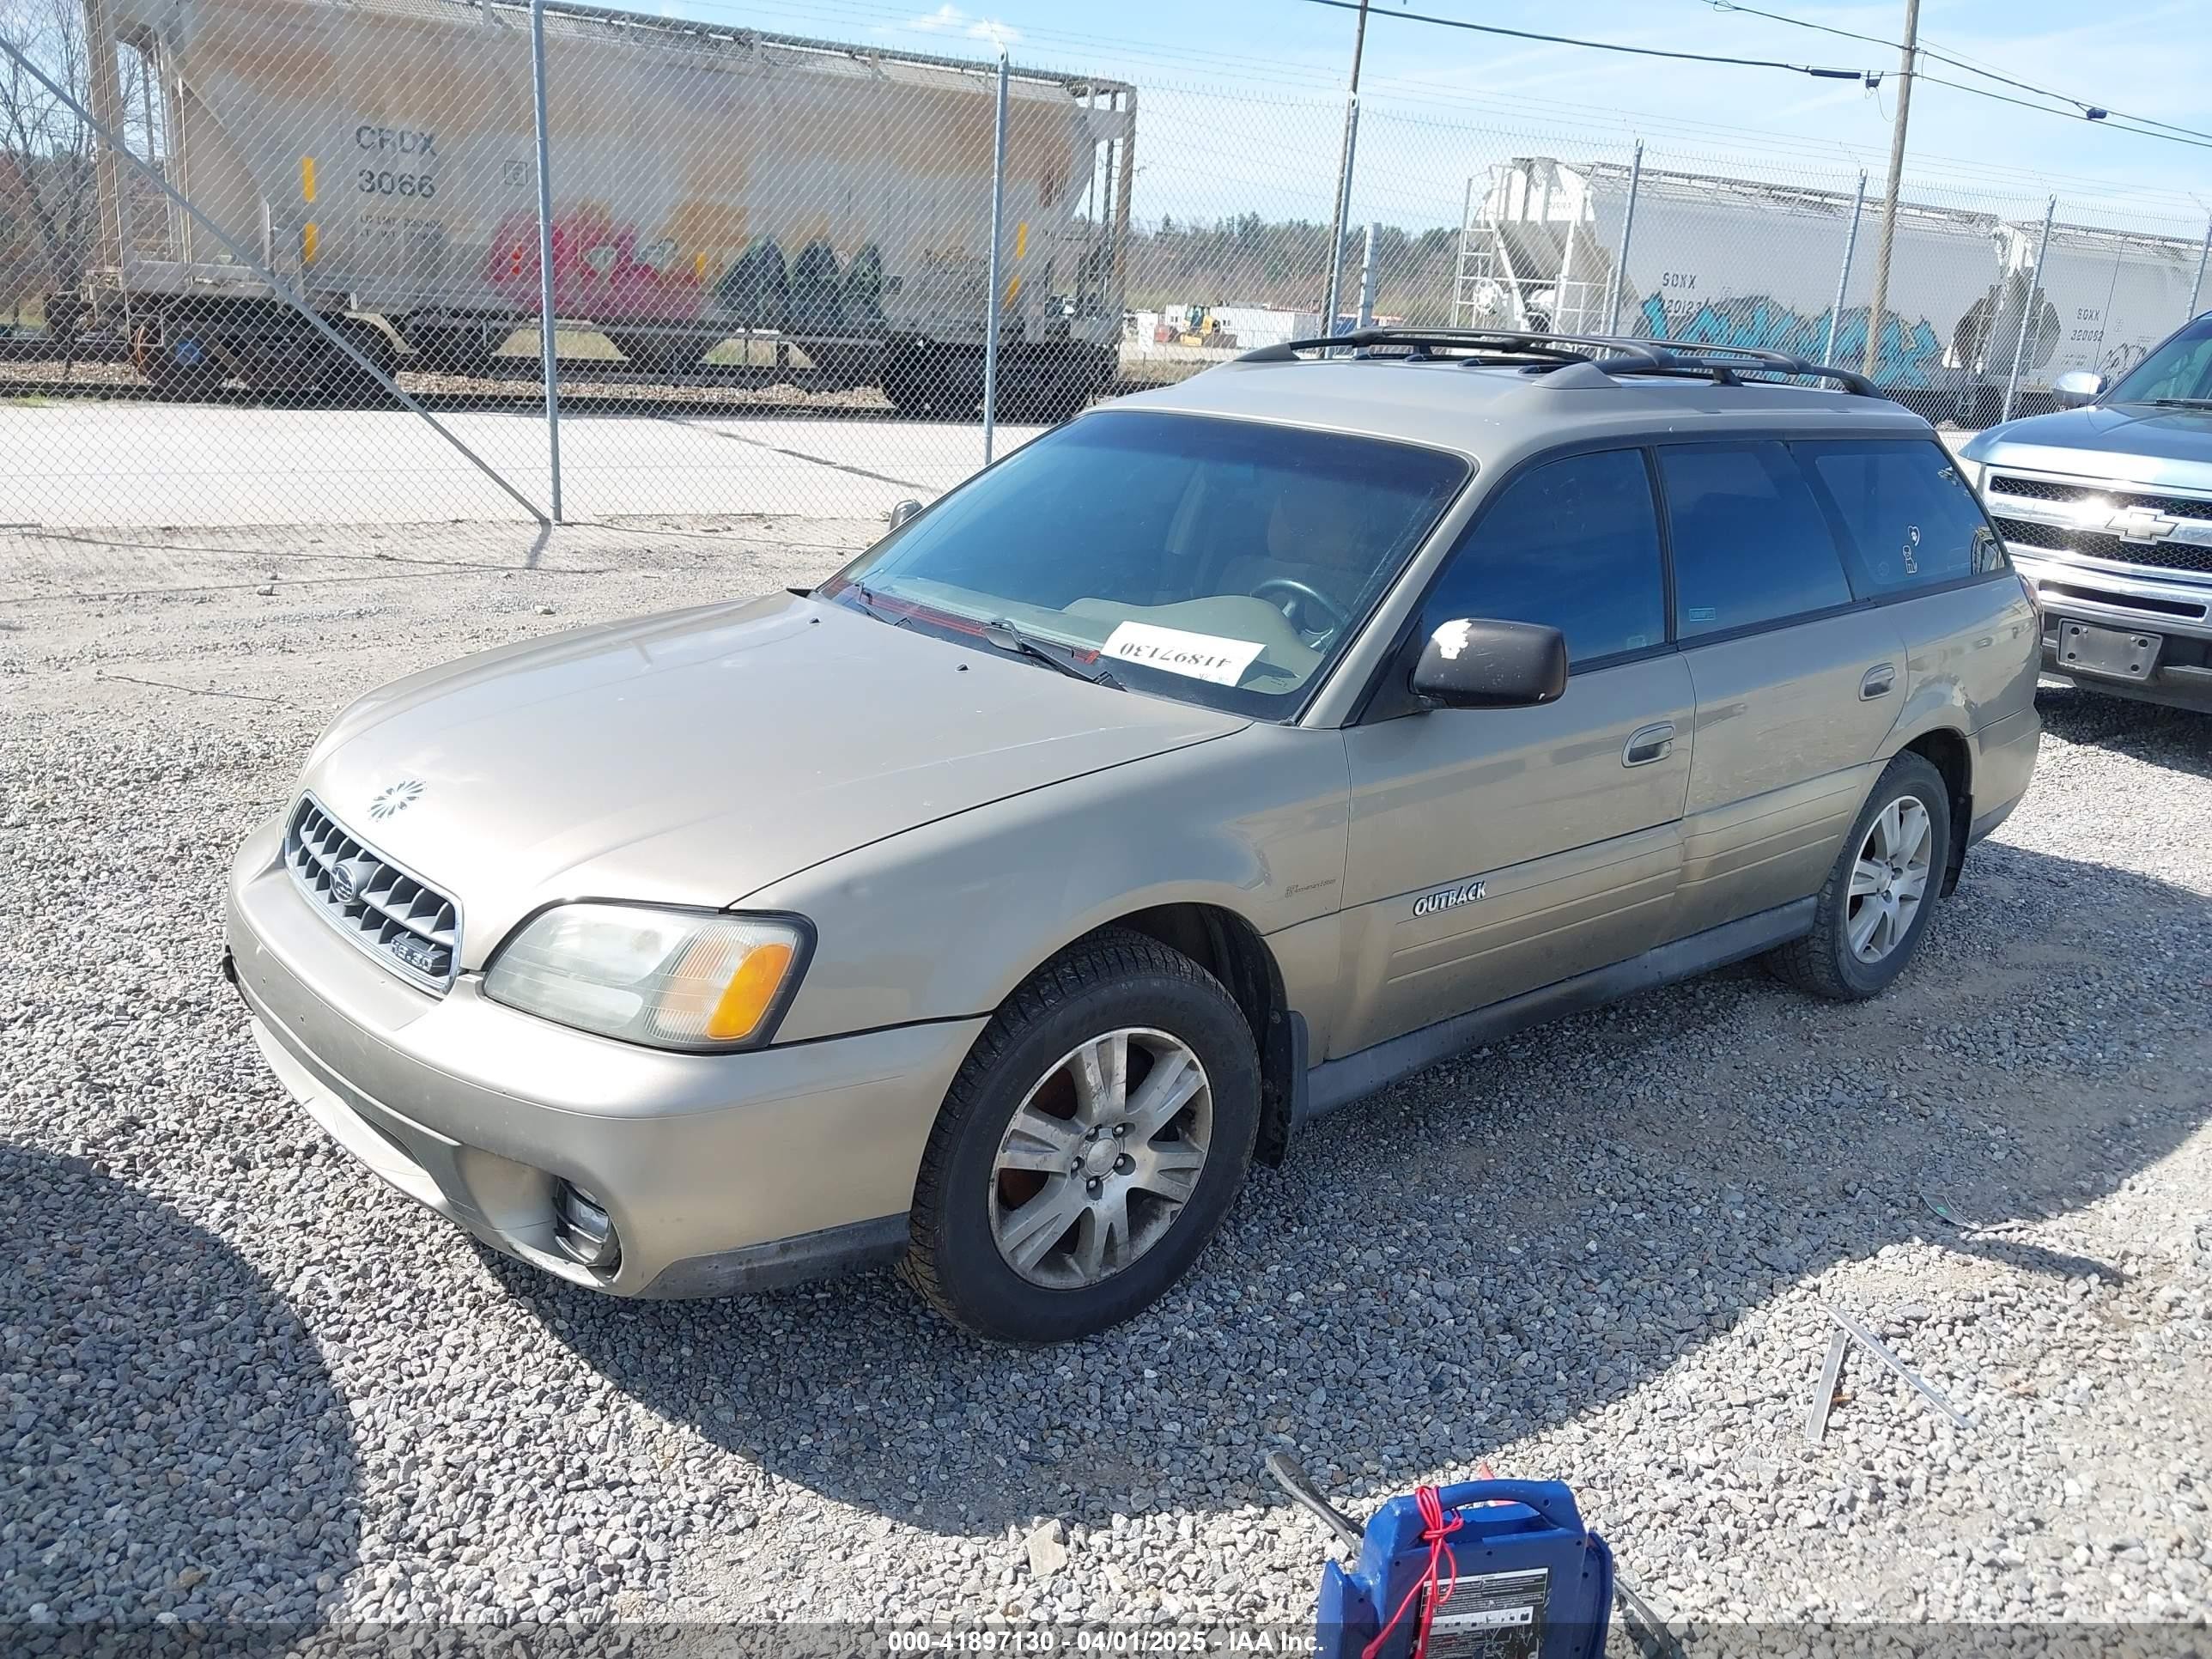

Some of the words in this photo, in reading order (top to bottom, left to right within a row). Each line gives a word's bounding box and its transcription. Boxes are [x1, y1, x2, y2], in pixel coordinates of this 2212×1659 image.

[356, 125, 437, 156] CRDX
[358, 168, 436, 198] 3066
[1662, 272, 1697, 289] SOXX
[1119, 641, 1233, 669] 41897130
[1413, 880, 1487, 917] OUTBACK
